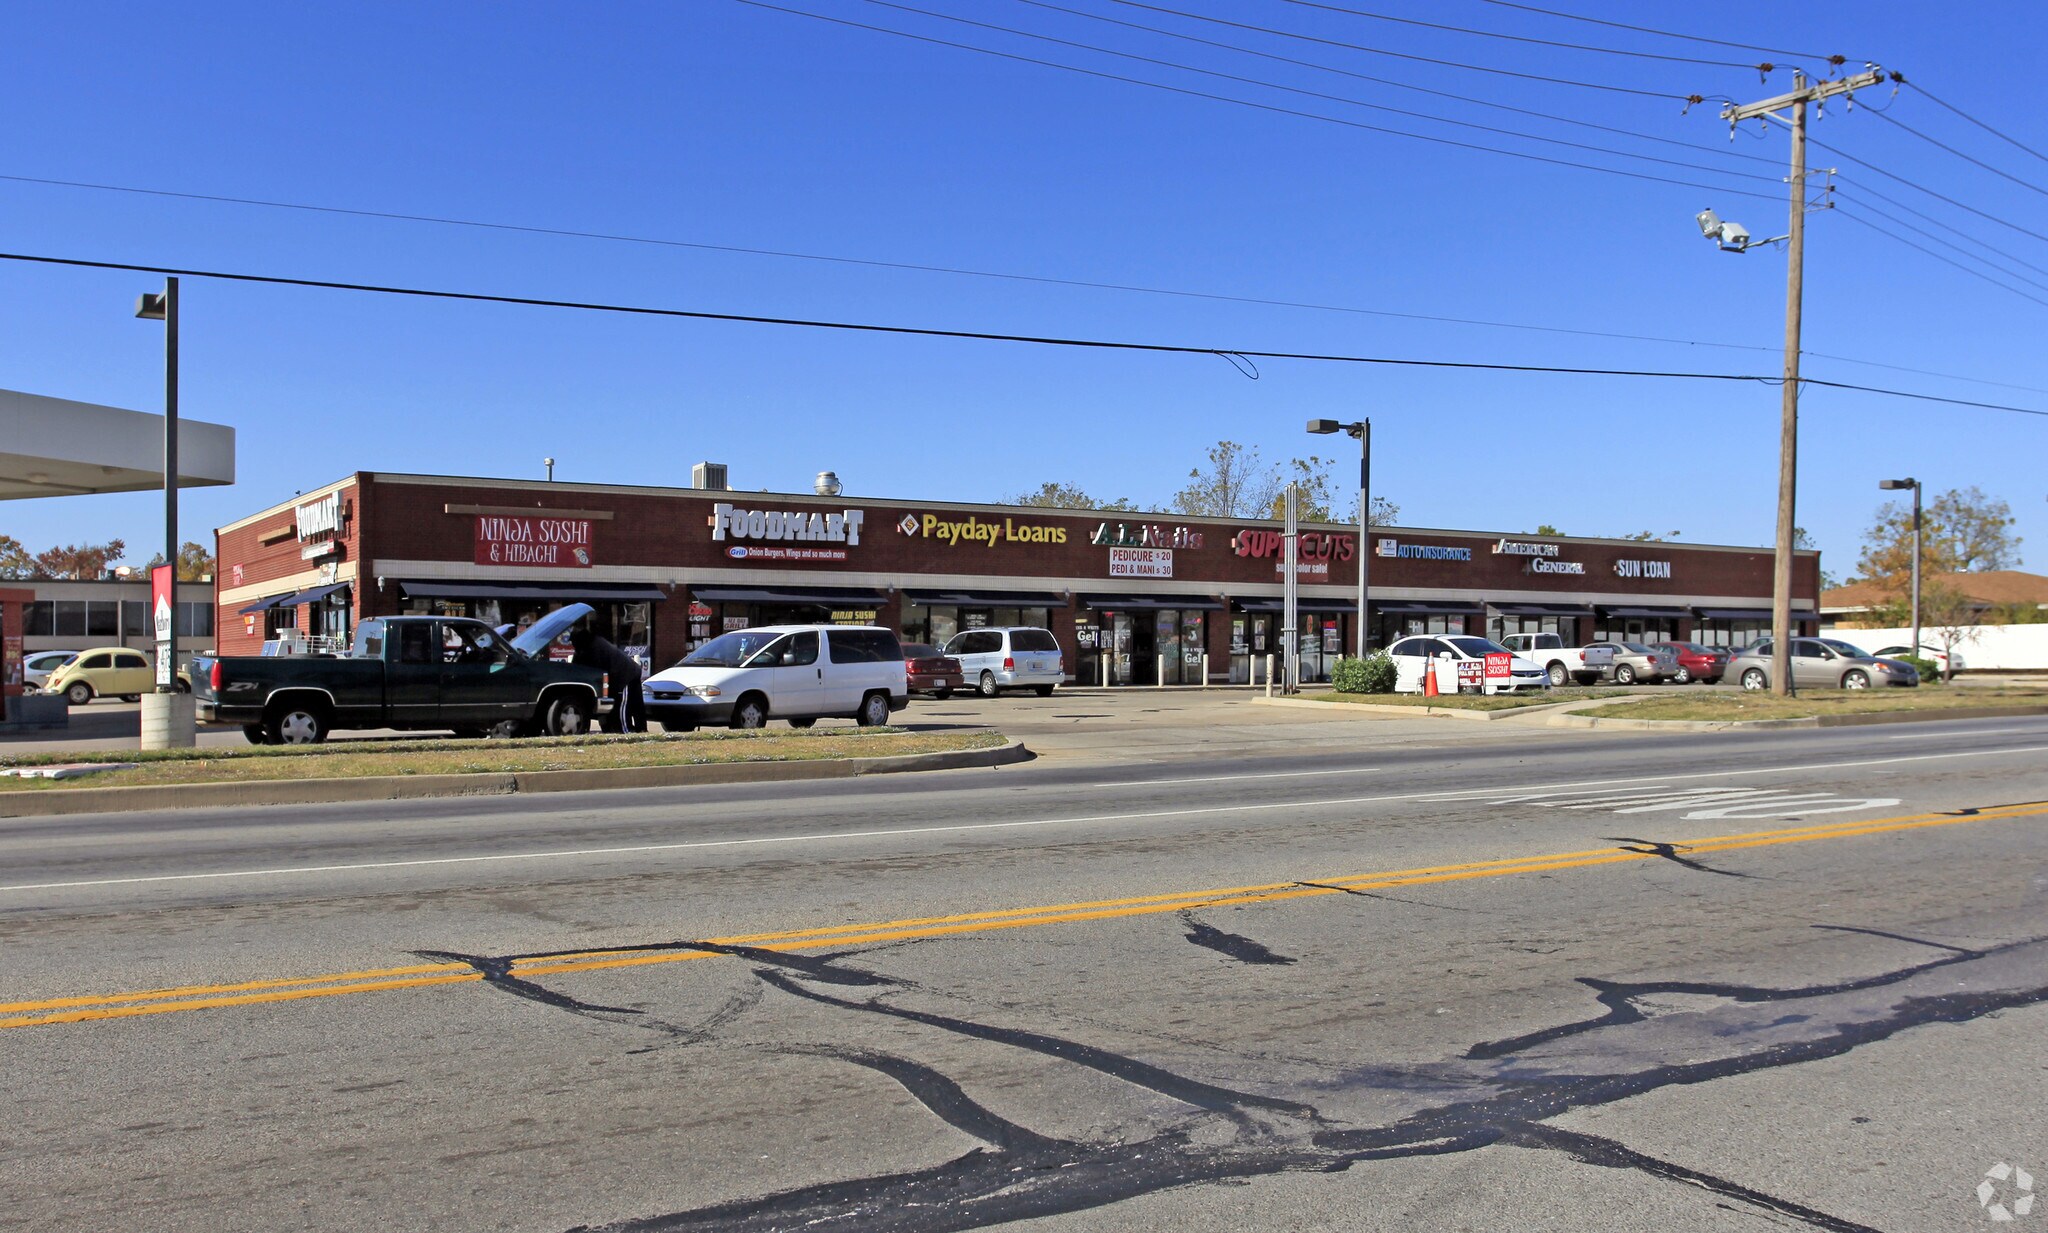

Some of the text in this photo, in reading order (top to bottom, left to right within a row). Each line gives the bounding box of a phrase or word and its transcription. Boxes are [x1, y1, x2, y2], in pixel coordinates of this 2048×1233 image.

[480, 517, 589, 544] NINJA SUSHI
[712, 503, 864, 546] FOODMART
[922, 514, 1067, 547] Payday Loans
[1140, 525, 1204, 549] Nails
[1236, 529, 1354, 561] SUPECUTS
[490, 543, 558, 563] & HIBACHI
[730, 548, 747, 556] Grill
[748, 547, 764, 556] Onion
[764, 549, 785, 559] Burgers,
[786, 549, 801, 559] Wings
[801, 550, 811, 558] and
[819, 550, 832, 558] much
[833, 551, 845, 559] more
[1112, 549, 1153, 562] PEDICURE
[1161, 552, 1171, 561] 20
[1397, 544, 1471, 561] AUTO INSURANCE
[1494, 538, 1559, 556] AMERICAN
[1111, 564, 1128, 573] PEDI
[1129, 564, 1135, 574] &
[1136, 565, 1155, 575] MANI
[1162, 566, 1171, 575] 30
[1311, 563, 1328, 574] sale!
[1532, 557, 1586, 575] GENERAL
[1618, 559, 1671, 578] SUN LOAN
[831, 610, 877, 620] NINJA SUSHI
[1077, 630, 1096, 641] Gel
[1184, 652, 1202, 663] Gel
[1487, 656, 1509, 665] NINJA
